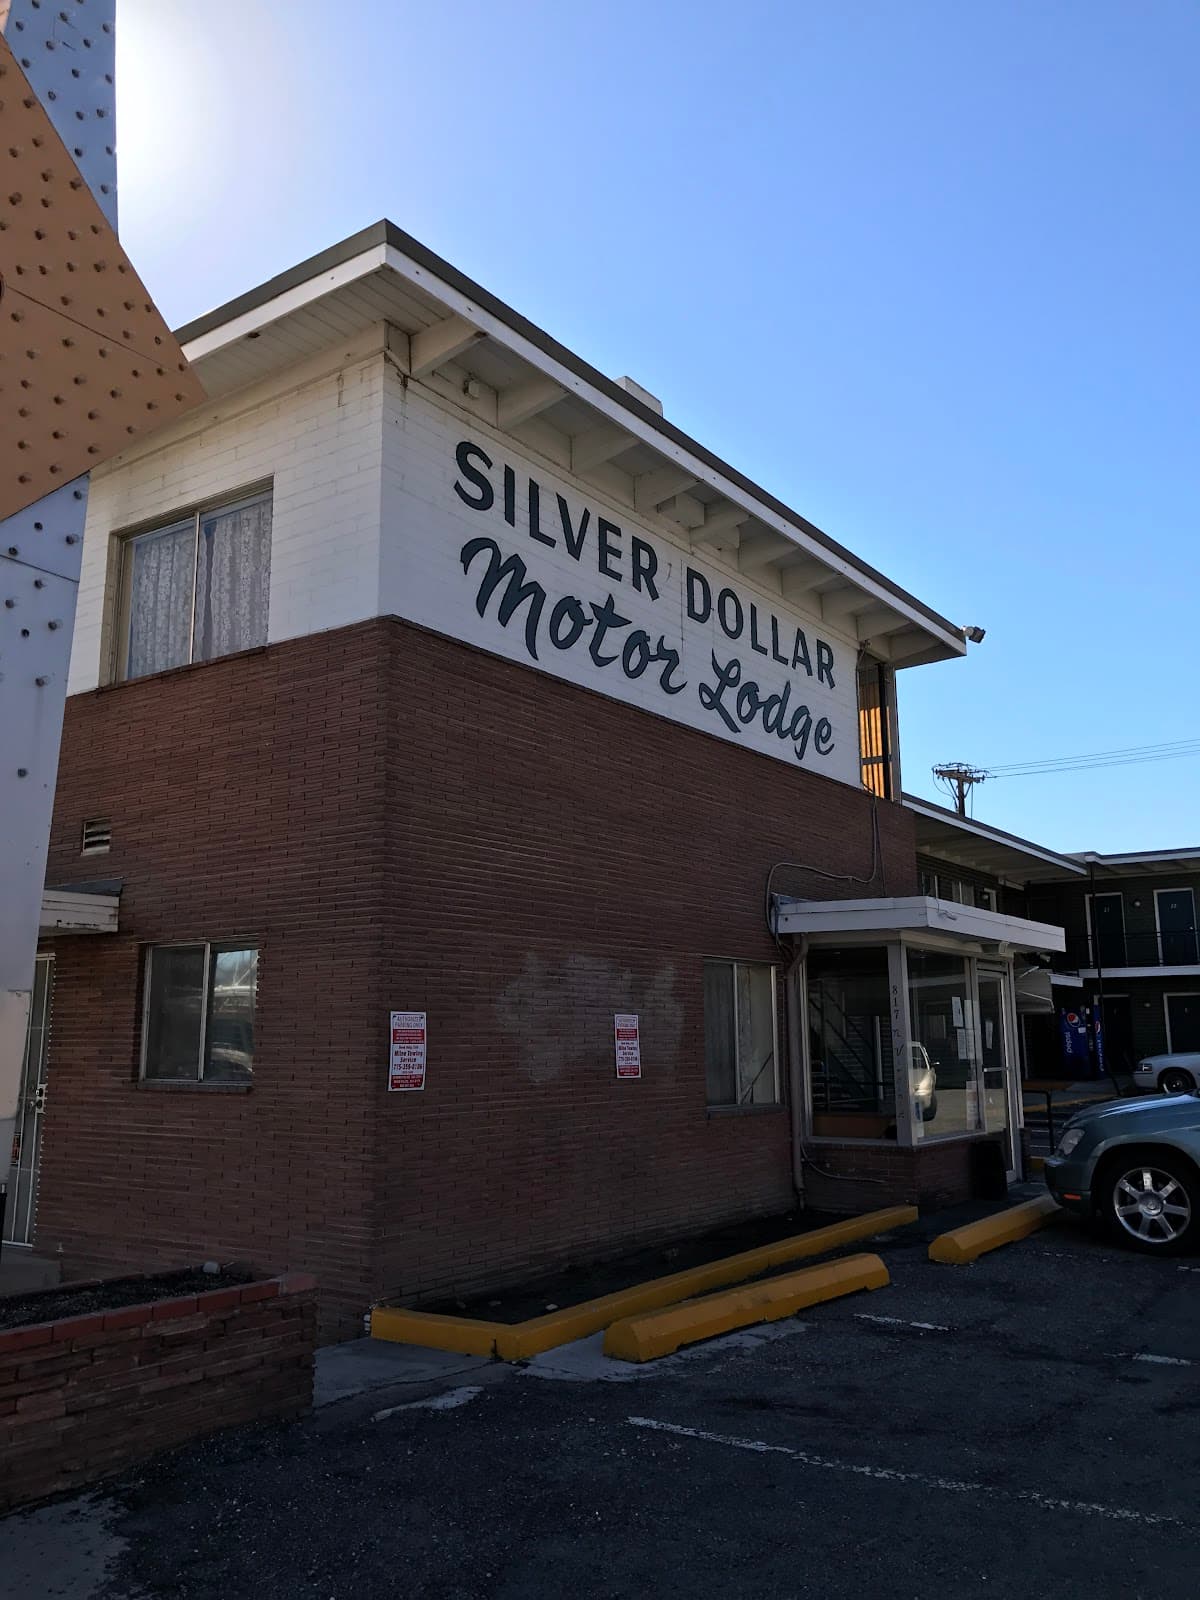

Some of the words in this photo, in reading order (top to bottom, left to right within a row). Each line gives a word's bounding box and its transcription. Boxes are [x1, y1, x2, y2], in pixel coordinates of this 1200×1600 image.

[453, 440, 660, 601] SILVER
[686, 566, 836, 690] DOLLAR
[459, 536, 688, 695] Motor
[699, 648, 835, 761] Lodge
